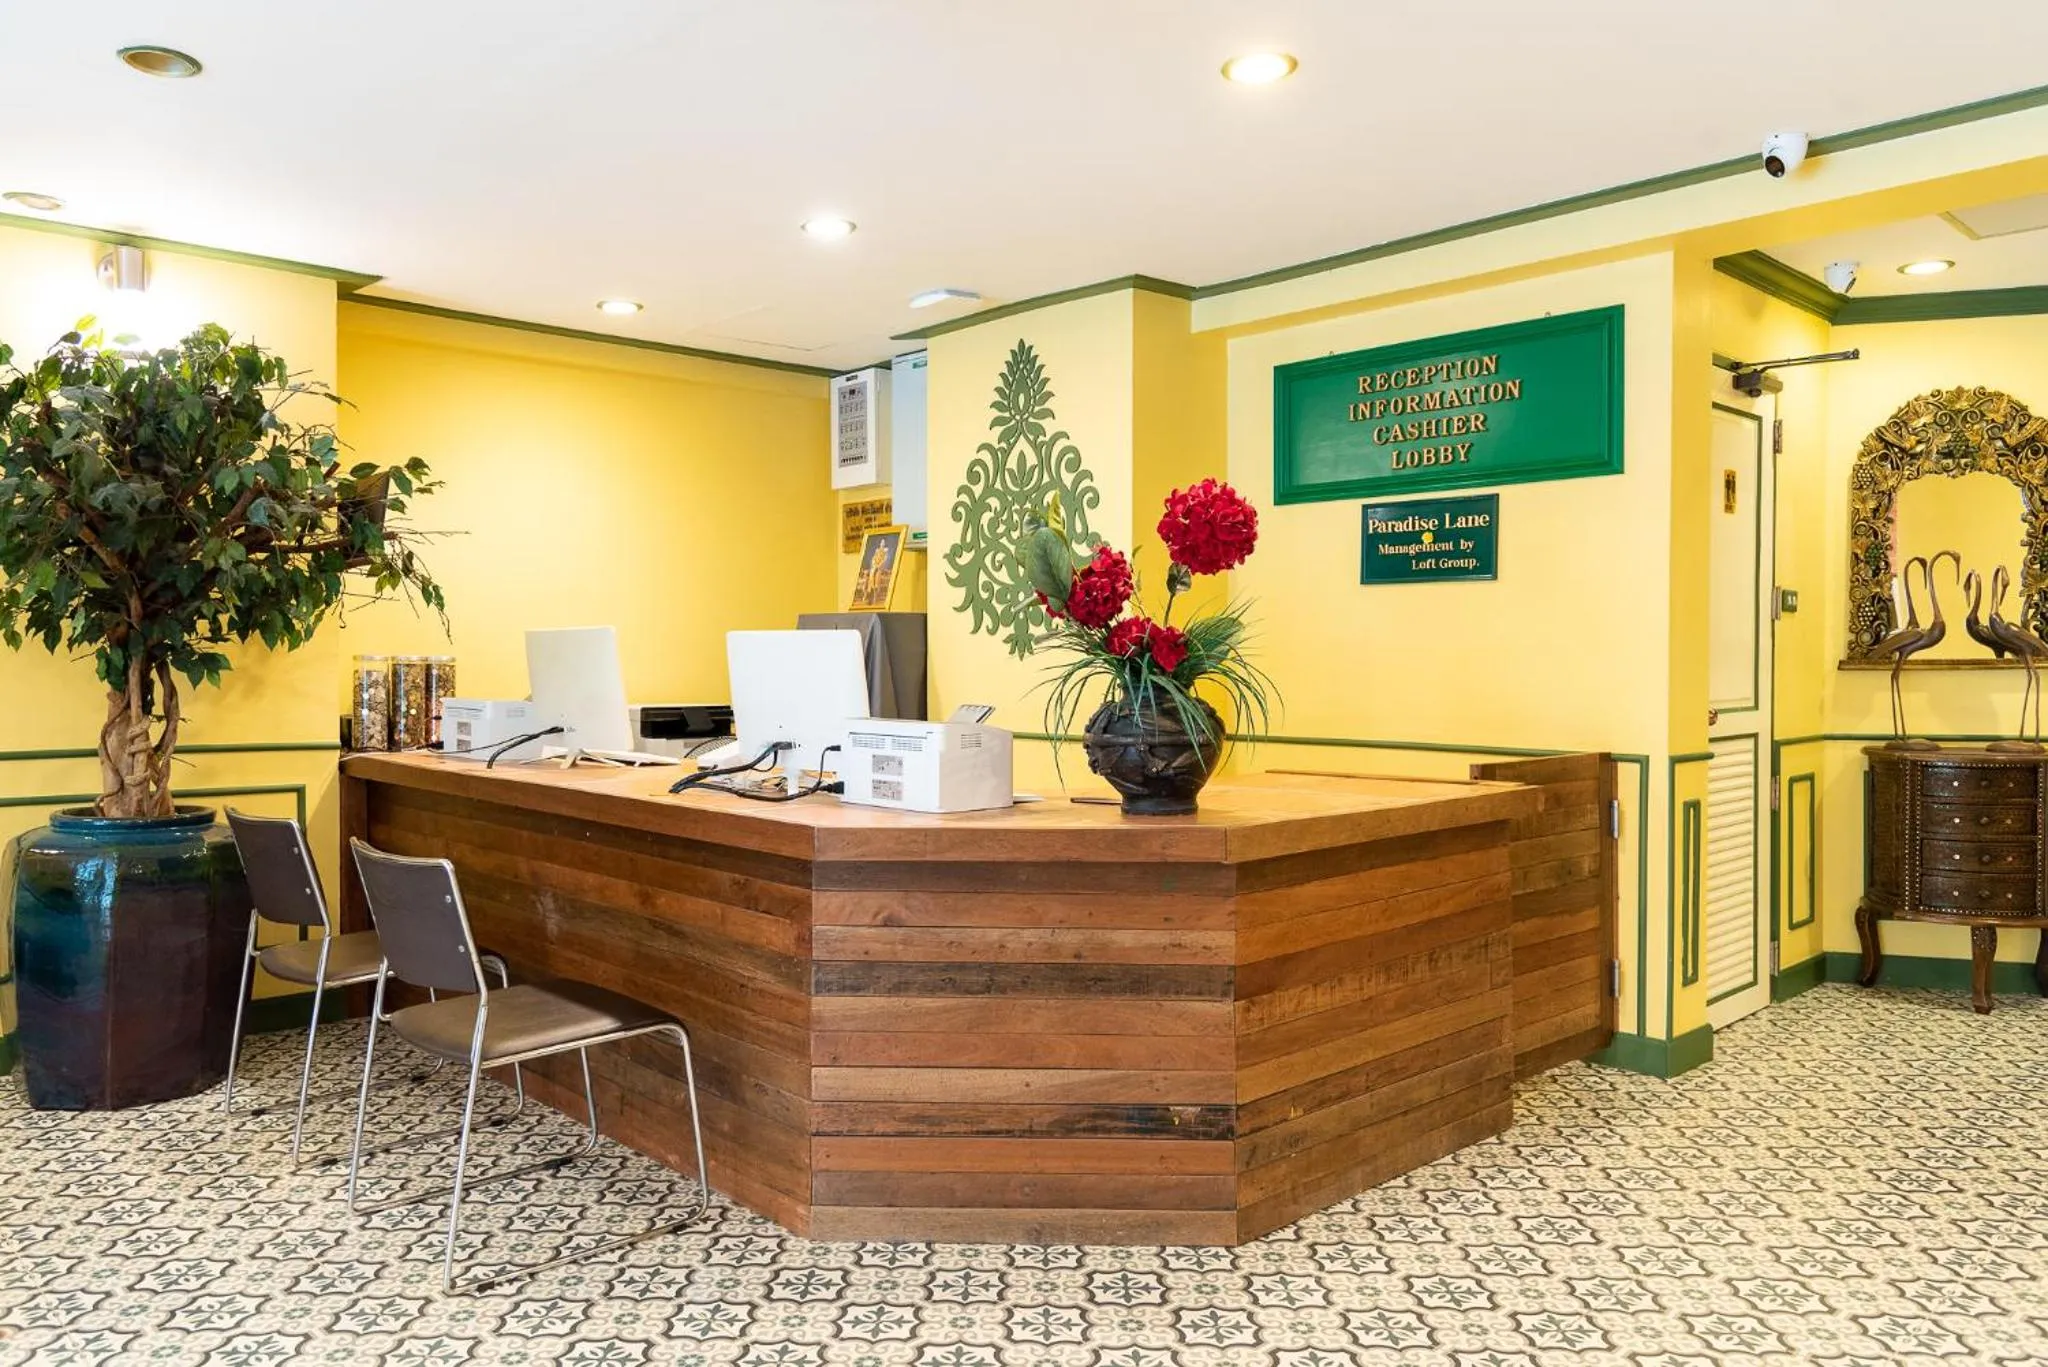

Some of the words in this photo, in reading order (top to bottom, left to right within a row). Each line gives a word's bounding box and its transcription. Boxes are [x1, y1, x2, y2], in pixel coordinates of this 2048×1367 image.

[1357, 354, 1498, 394] RECEPTION
[1348, 379, 1521, 421] INFORMATION
[1373, 413, 1487, 445] CASHIER
[1391, 442, 1472, 470] LOBBY
[1368, 516, 1439, 534] Paradise
[1444, 512, 1490, 529] Lane
[1378, 540, 1454, 556] Management
[1460, 539, 1474, 552] by
[1412, 558, 1437, 570] Loft
[1439, 557, 1480, 570] Group.
